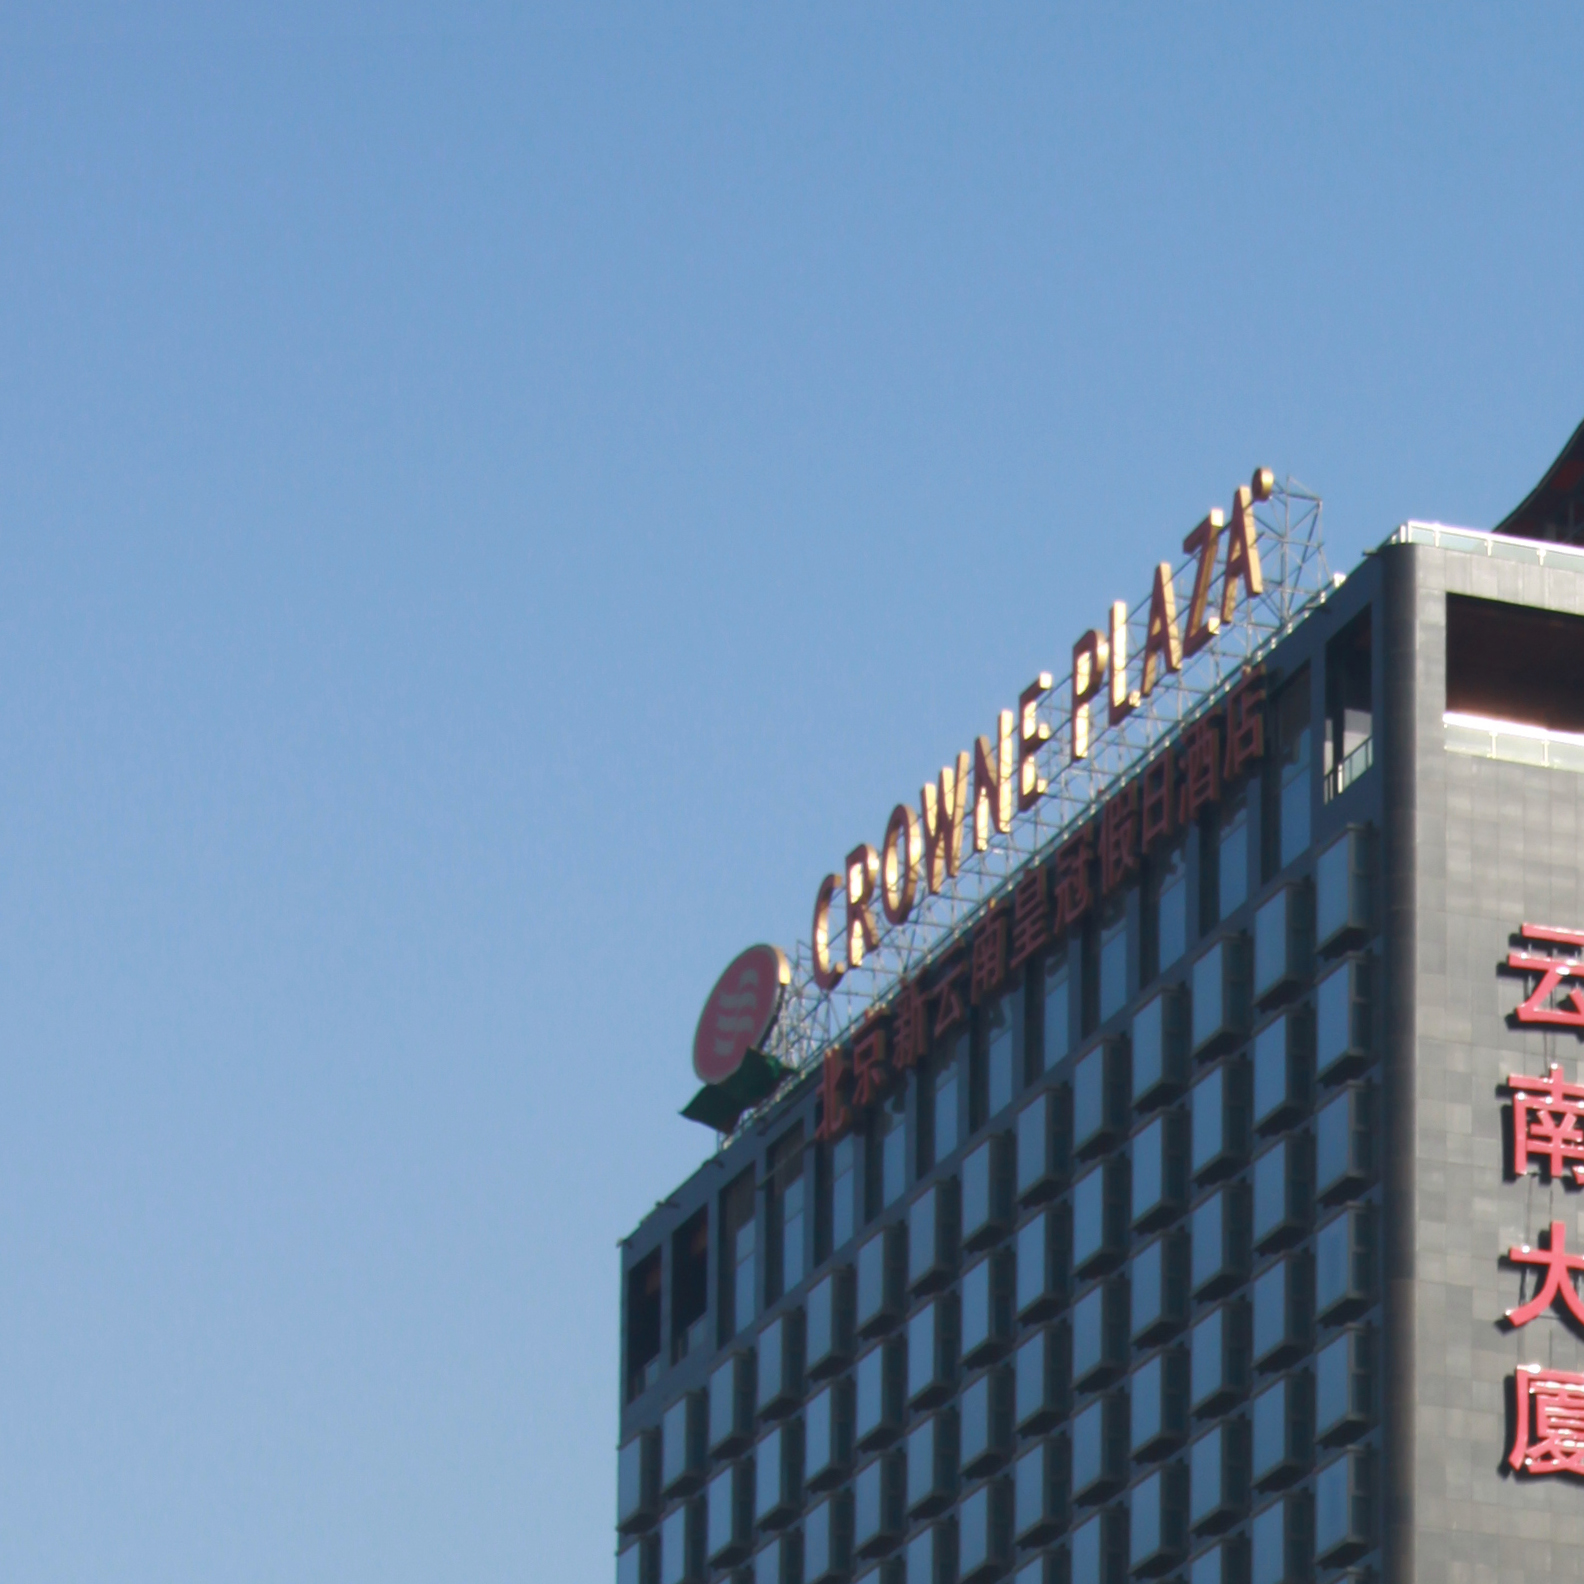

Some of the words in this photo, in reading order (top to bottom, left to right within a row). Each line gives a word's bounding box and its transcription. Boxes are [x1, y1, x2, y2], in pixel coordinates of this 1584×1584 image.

[811, 671, 1053, 991] CROWNE
[1072, 485, 1264, 761] PLAZA
[815, 661, 1267, 1141] 北京新云南皇冠假日酒店
